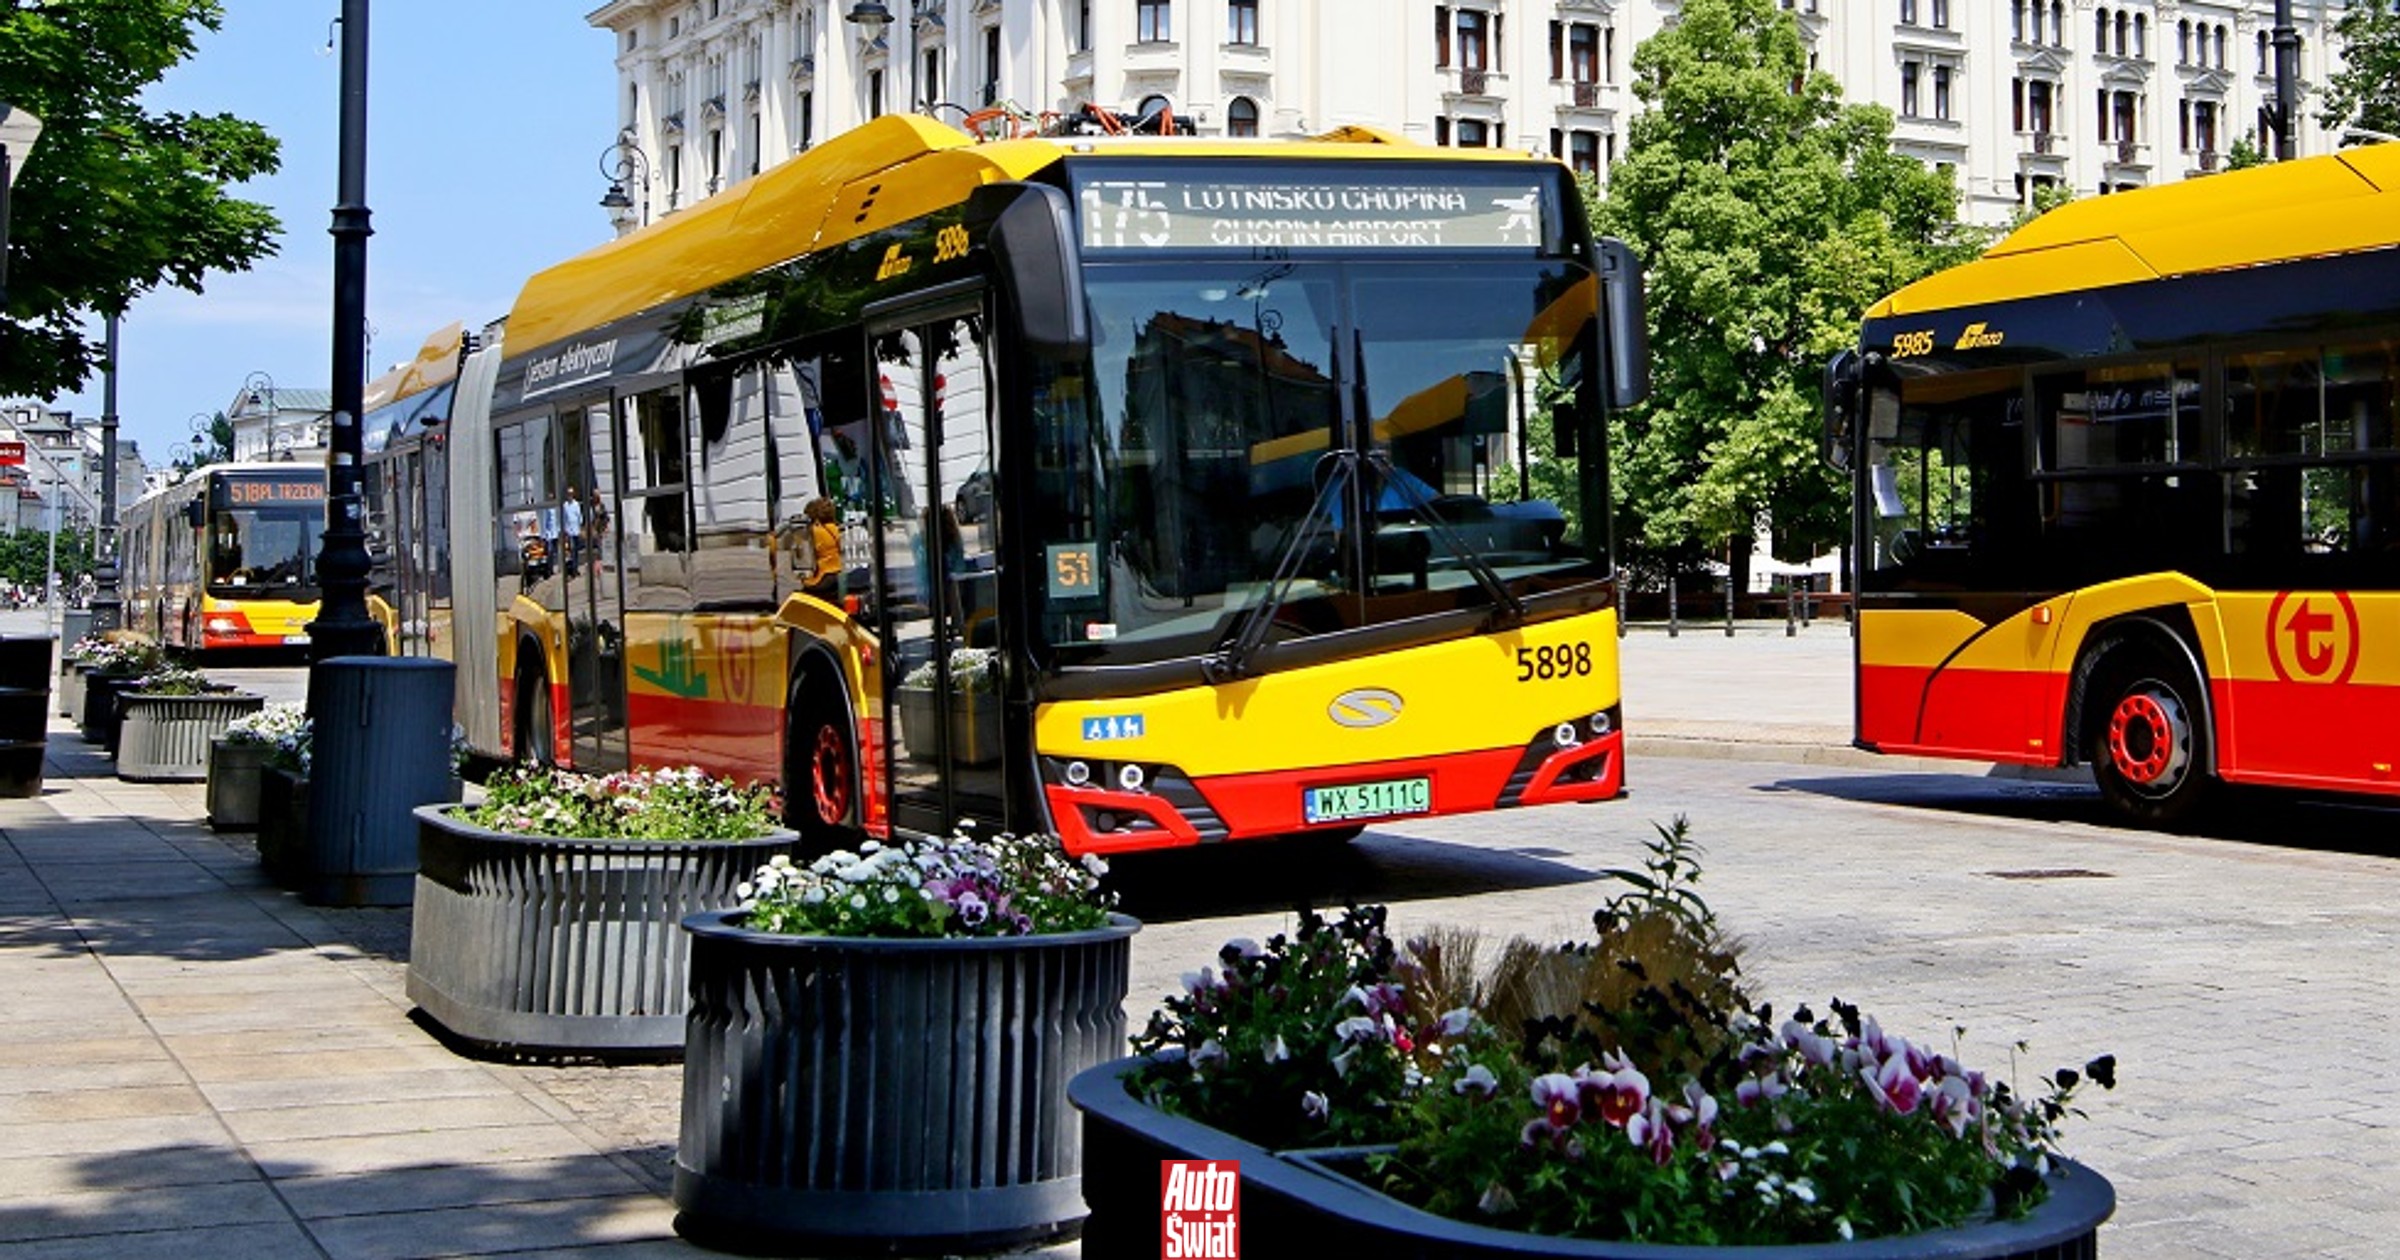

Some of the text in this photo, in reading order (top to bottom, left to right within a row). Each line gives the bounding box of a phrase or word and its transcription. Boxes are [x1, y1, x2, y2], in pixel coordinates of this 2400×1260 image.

[1183, 184, 1466, 211] LOTNISKO CHOPINA
[1081, 182, 1171, 246] 175
[1211, 219, 1441, 246] CHOPIN AIRPORT
[1891, 329, 1934, 359] 5985
[231, 483, 259, 503] 518
[1056, 552, 1090, 586] 51
[1517, 641, 1592, 682] 5898
[1320, 789, 1348, 814] WX
[1358, 781, 1424, 810] 5111C
